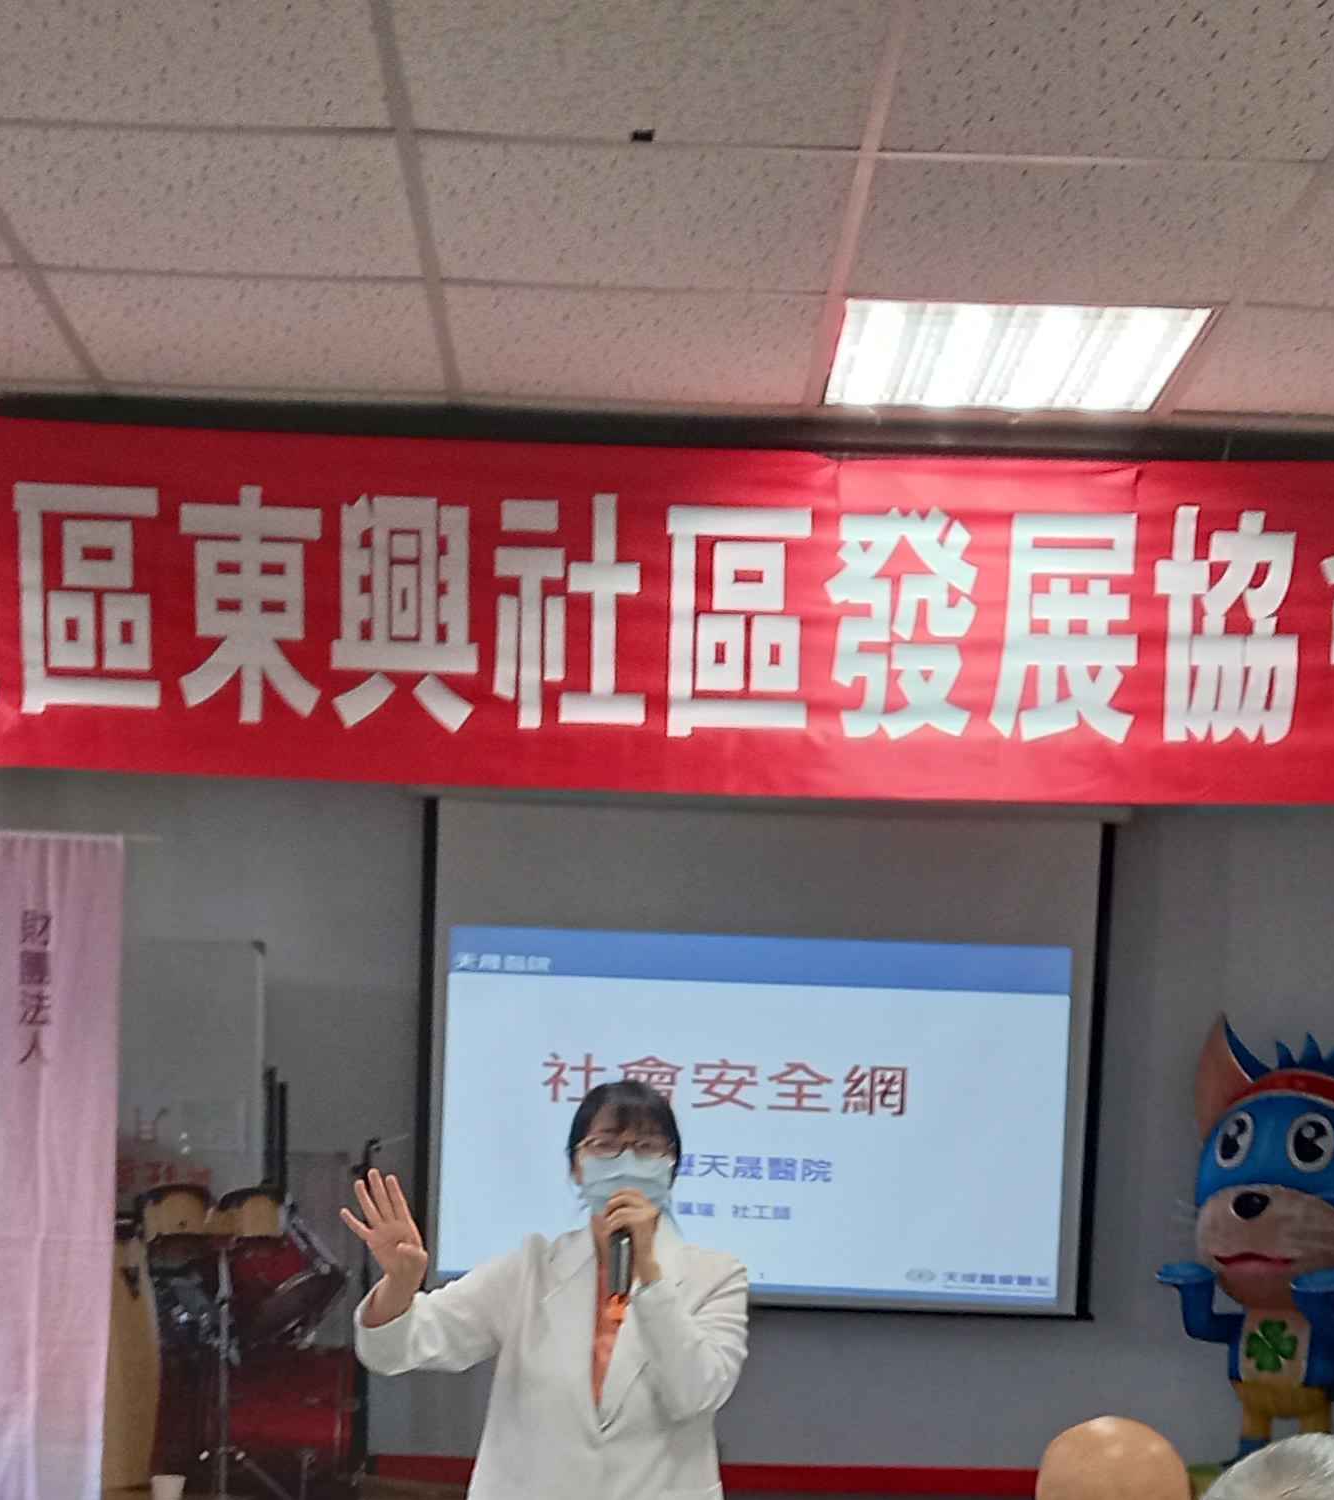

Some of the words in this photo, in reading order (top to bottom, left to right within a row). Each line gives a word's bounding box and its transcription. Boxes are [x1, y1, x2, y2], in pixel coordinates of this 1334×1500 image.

[542, 1052, 908, 1116] 社會安全網
